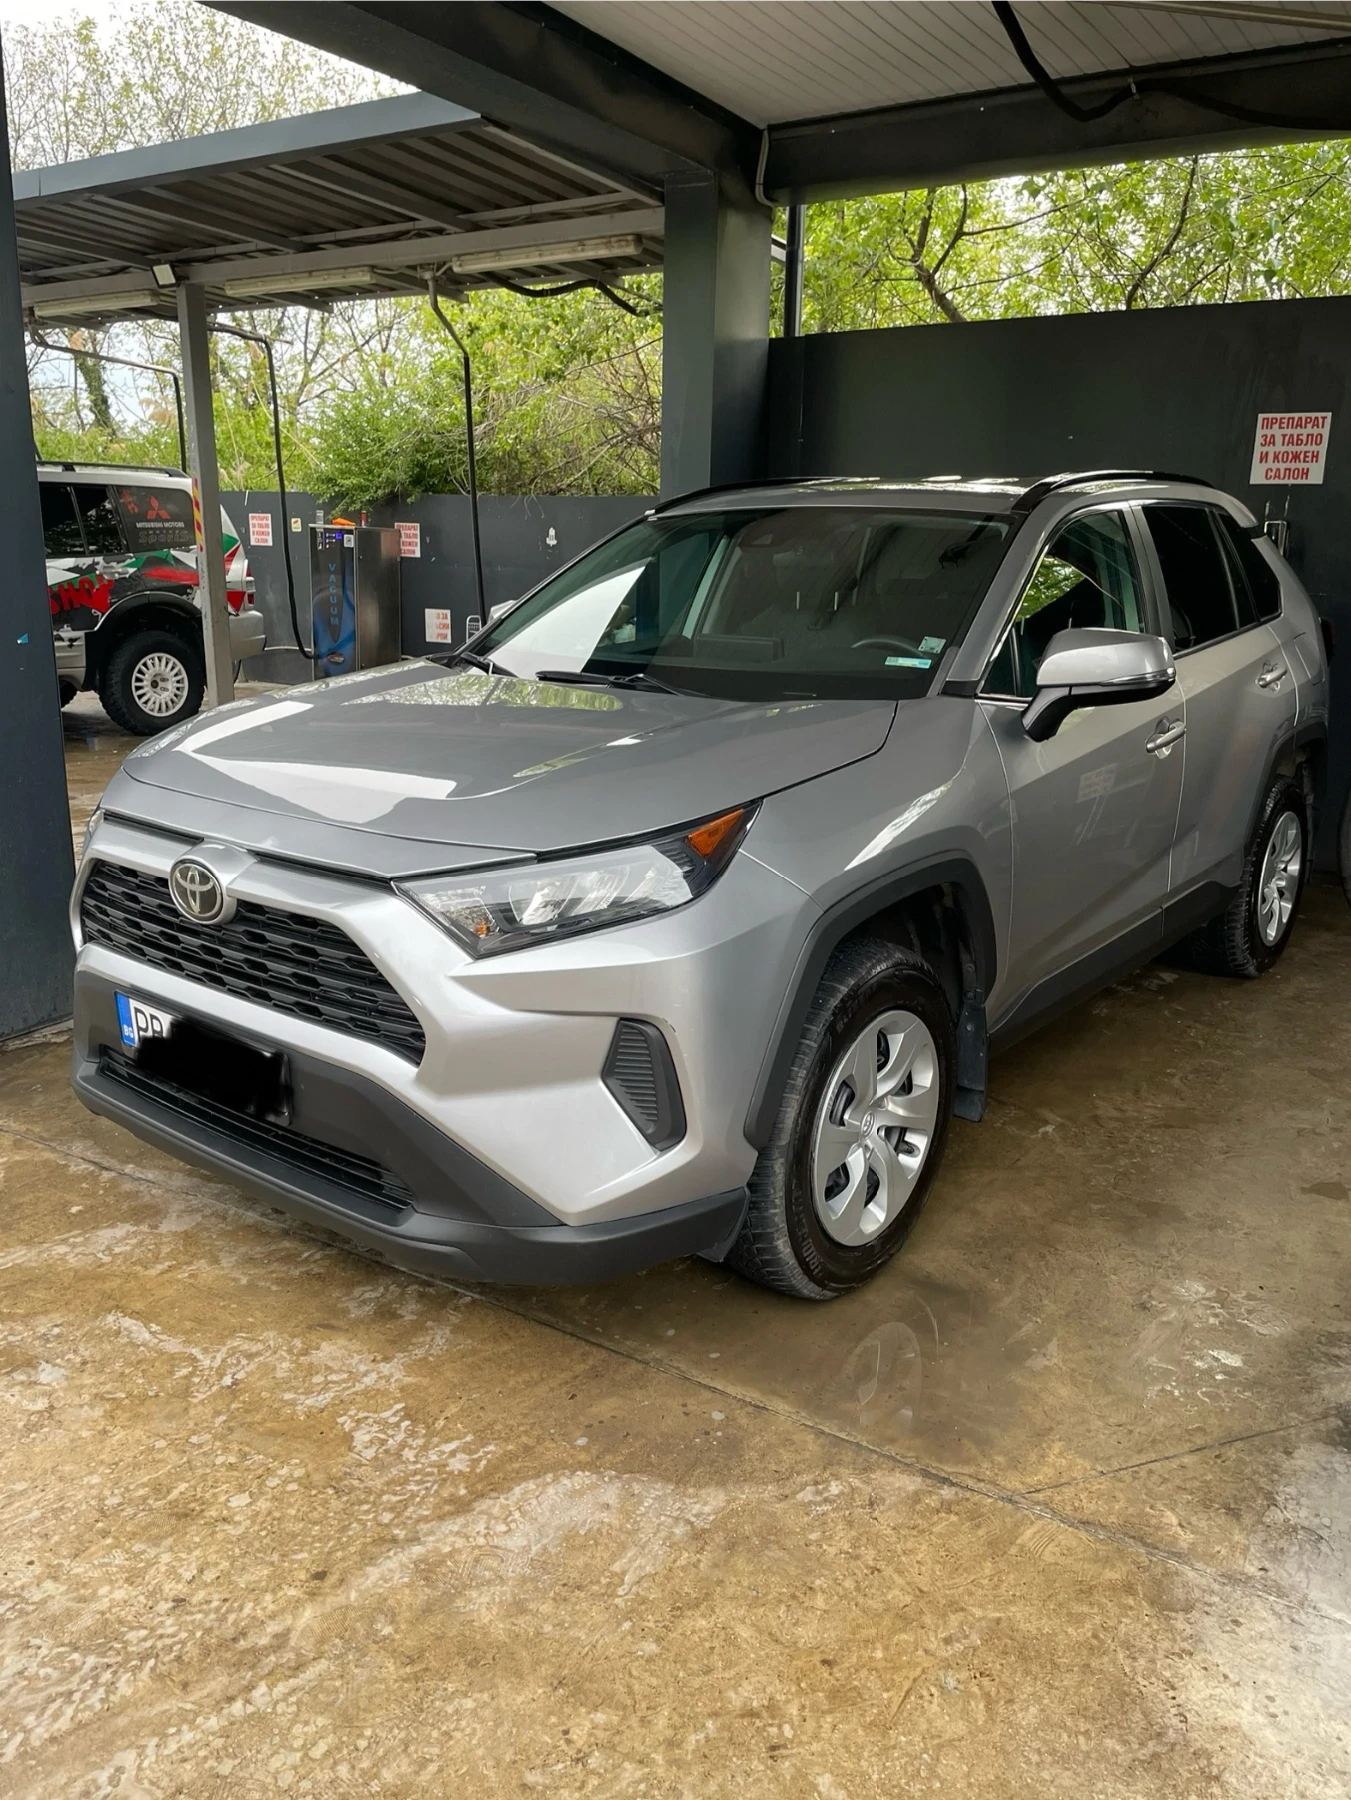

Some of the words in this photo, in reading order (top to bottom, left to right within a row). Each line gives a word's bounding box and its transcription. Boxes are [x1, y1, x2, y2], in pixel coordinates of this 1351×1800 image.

[1260, 416, 1328, 430] ПРЕПАРАТ
[1260, 434, 1276, 447] ЗА
[1281, 433, 1324, 447] ТАБЛО
[1259, 451, 1269, 464] И
[1272, 450, 1320, 464] КОЖЕН
[1264, 467, 1310, 481] САЛОН
[328, 563, 339, 626] VACUUM
[123, 1024, 134, 1039] BG
